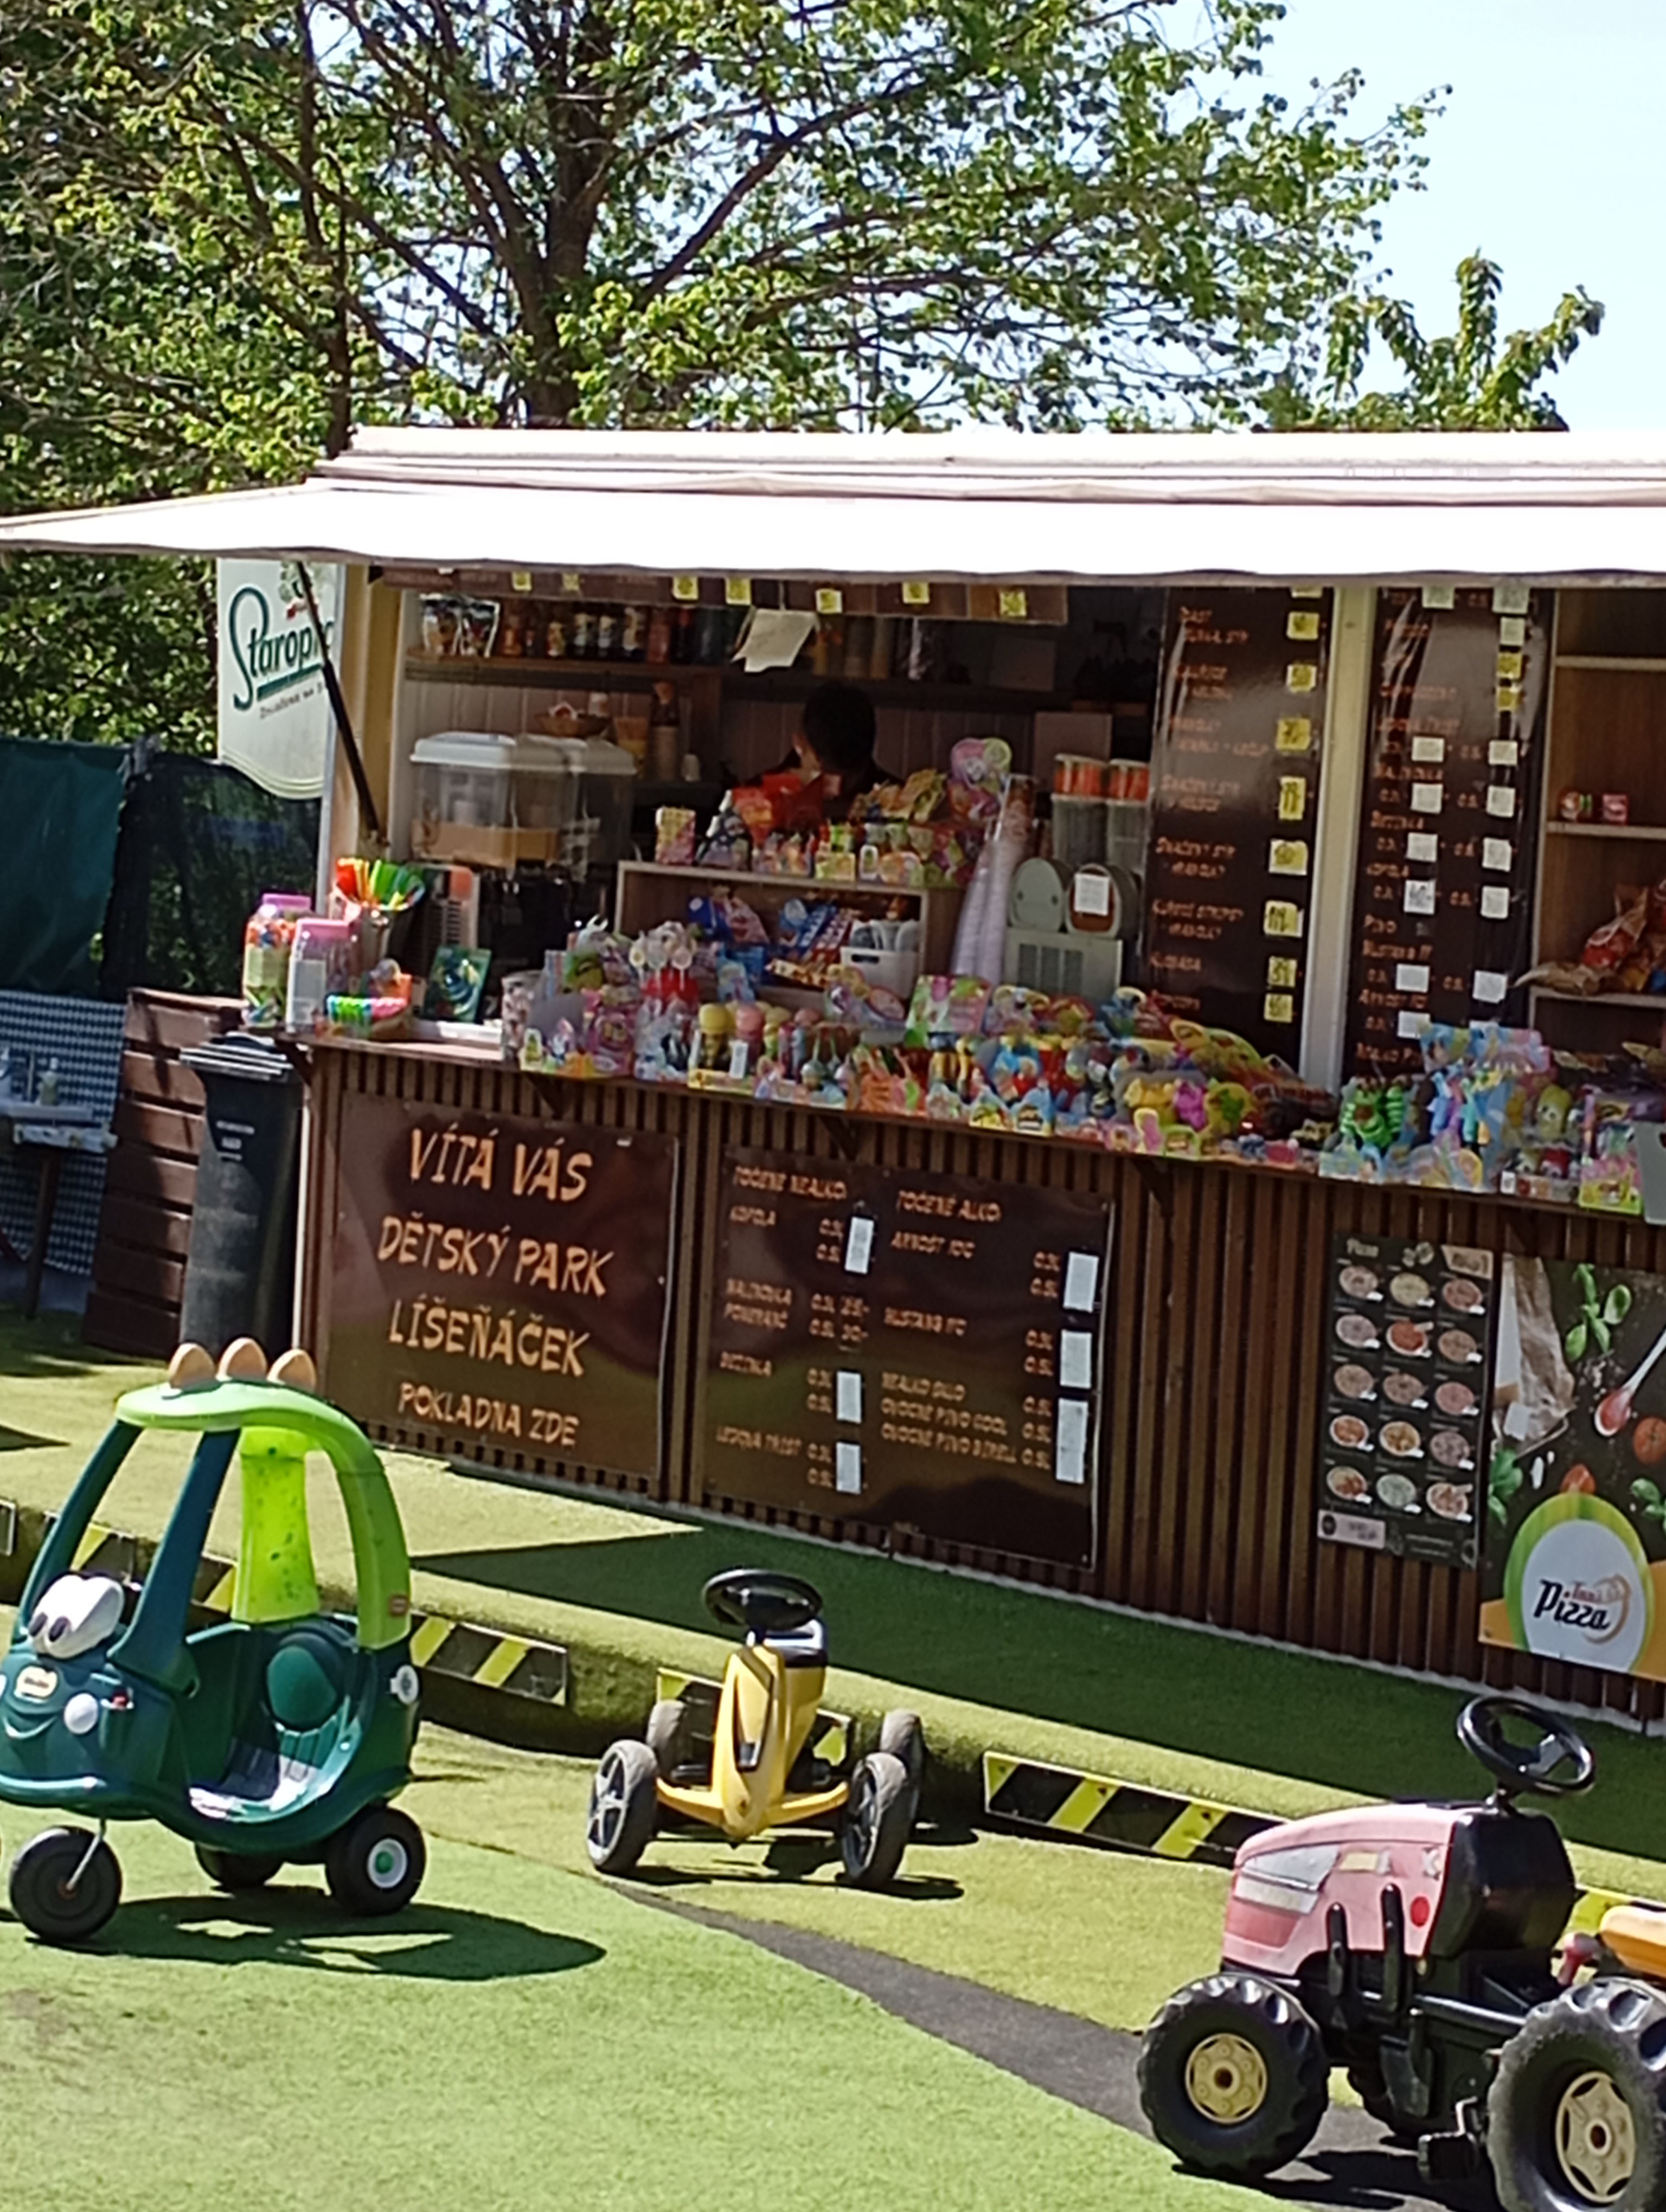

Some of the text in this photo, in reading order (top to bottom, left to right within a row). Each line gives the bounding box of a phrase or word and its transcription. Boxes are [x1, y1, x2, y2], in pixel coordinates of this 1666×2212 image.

[410, 1123, 592, 1201] VÍTÁ VÁS
[377, 1211, 614, 1296] DĚTSKÝ PARK
[389, 1293, 589, 1377] LÍŠEŇÁČEK
[398, 1382, 579, 1446] POKLADNA ZDE
[1533, 1579, 1611, 1630] Pizza
